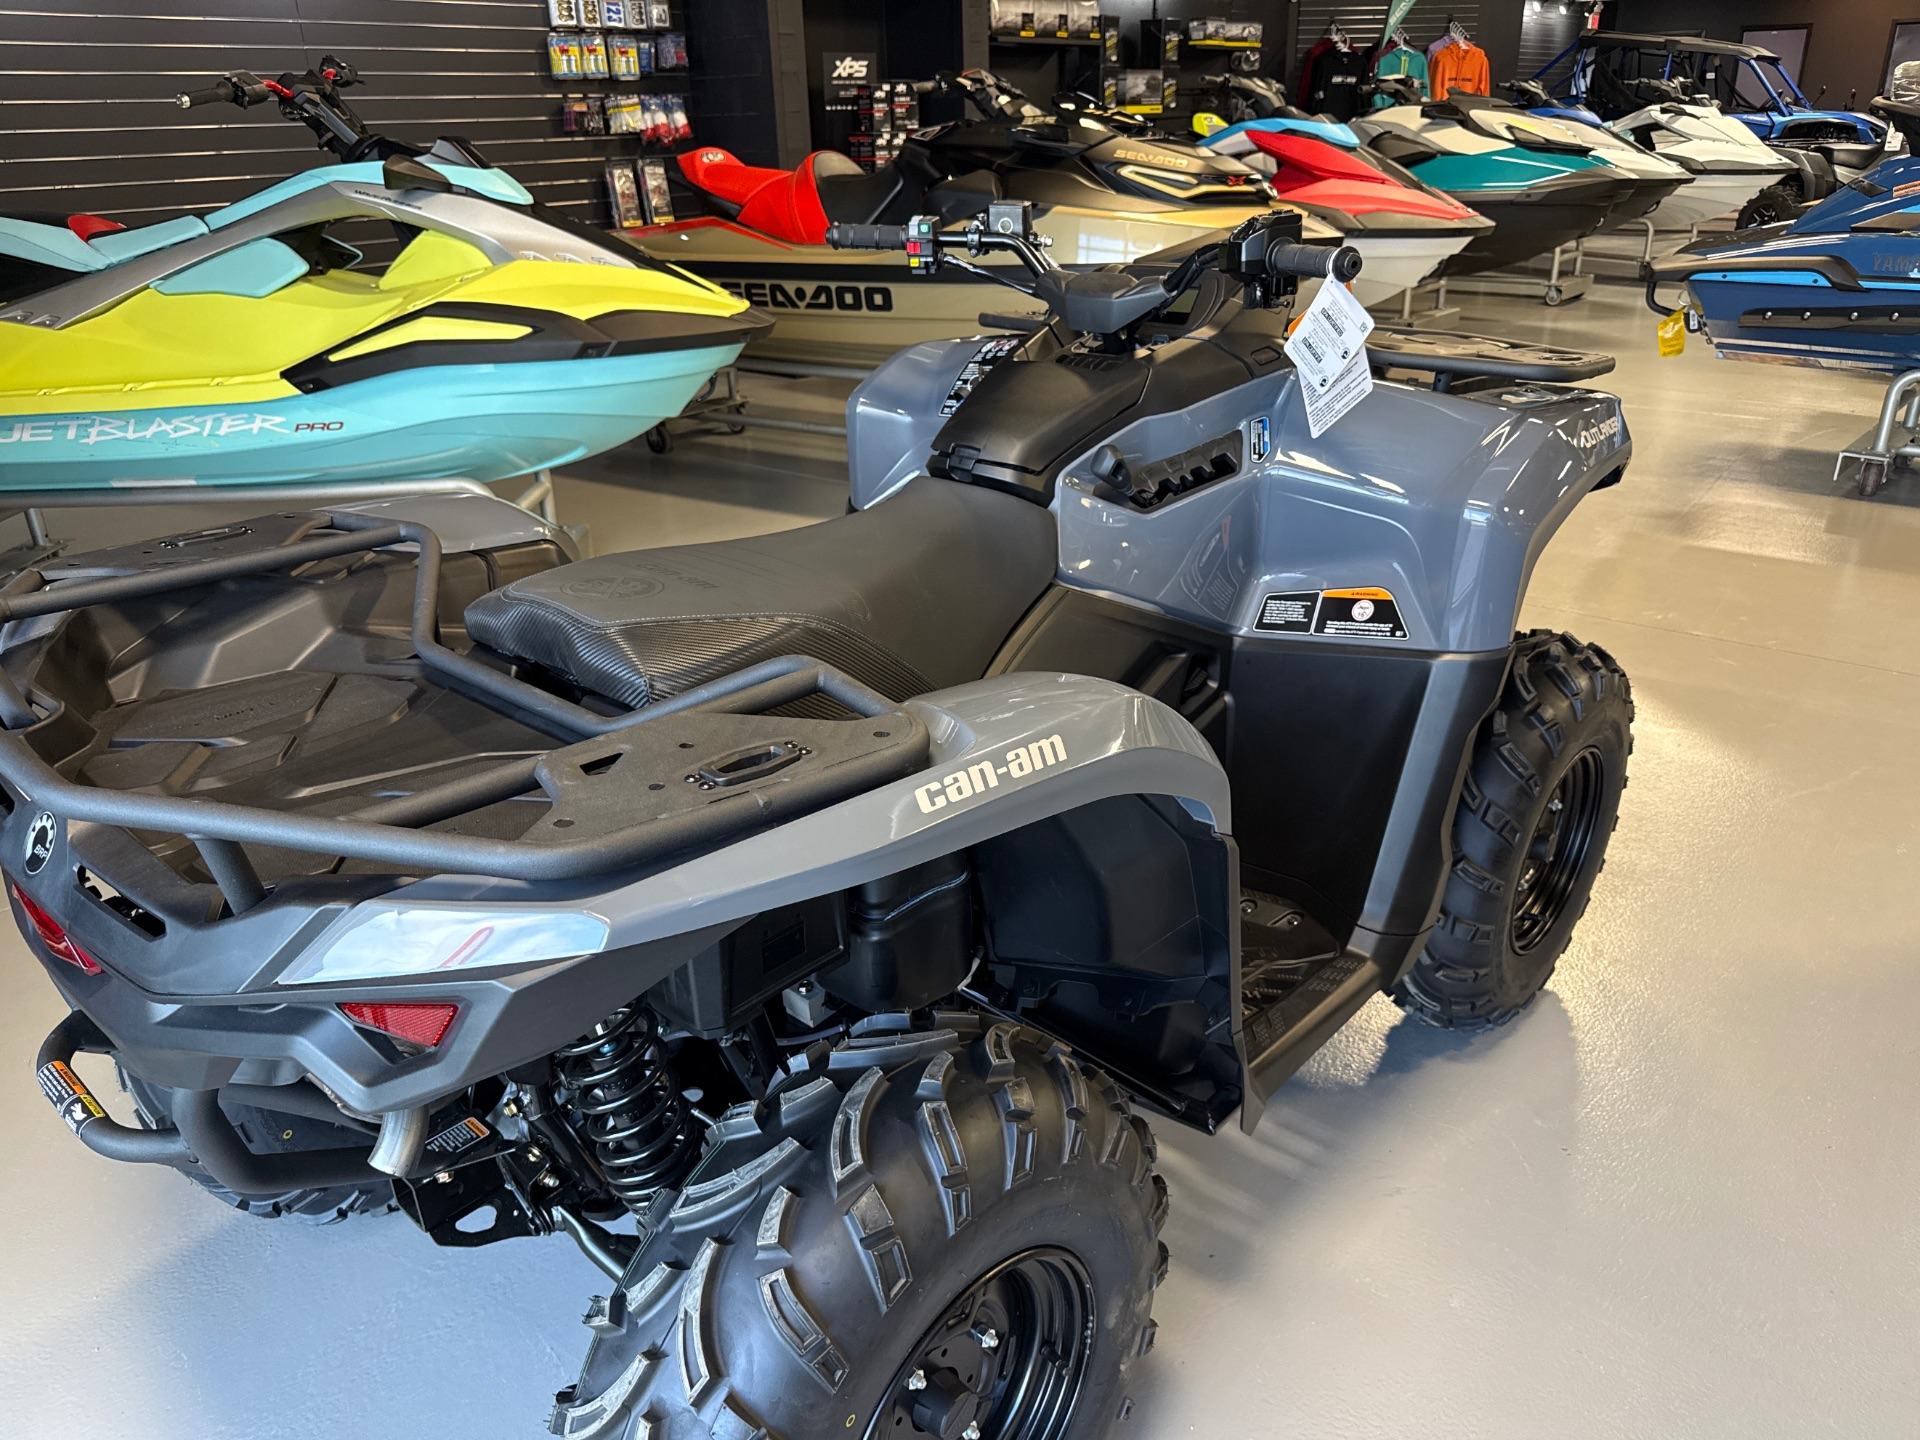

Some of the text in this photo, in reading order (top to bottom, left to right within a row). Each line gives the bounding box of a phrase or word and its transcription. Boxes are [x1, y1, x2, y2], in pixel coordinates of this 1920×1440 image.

[831, 56, 869, 77] XPS
[294, 421, 344, 433] PRO
[914, 734, 1068, 814] can-am
[34, 844, 49, 859] BRP
